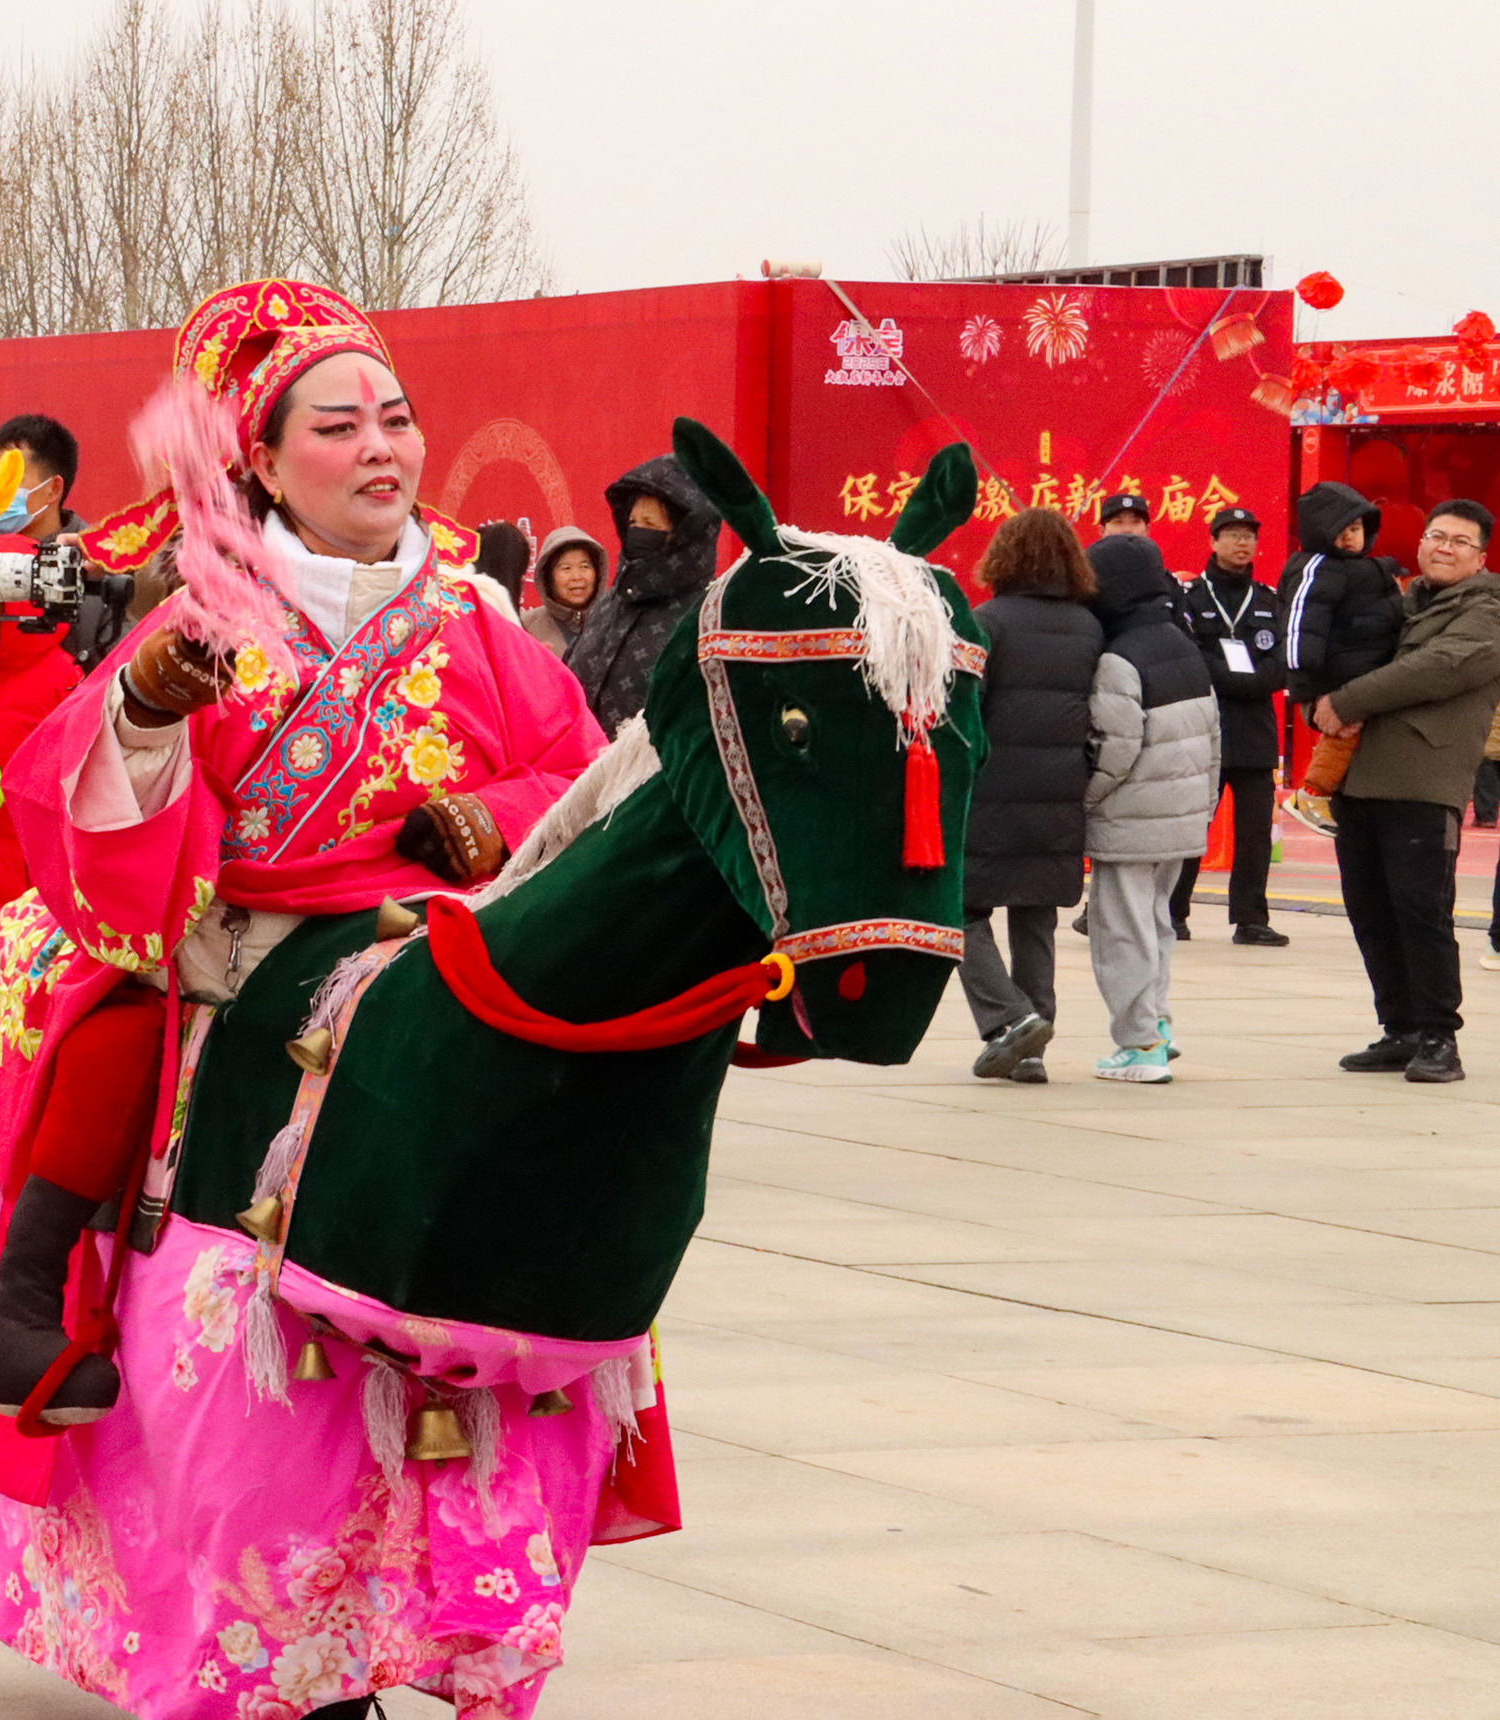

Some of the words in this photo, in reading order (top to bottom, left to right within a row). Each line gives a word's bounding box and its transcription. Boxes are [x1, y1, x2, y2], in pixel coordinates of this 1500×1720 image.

[838, 471, 1240, 524] 保定激店新庙会
